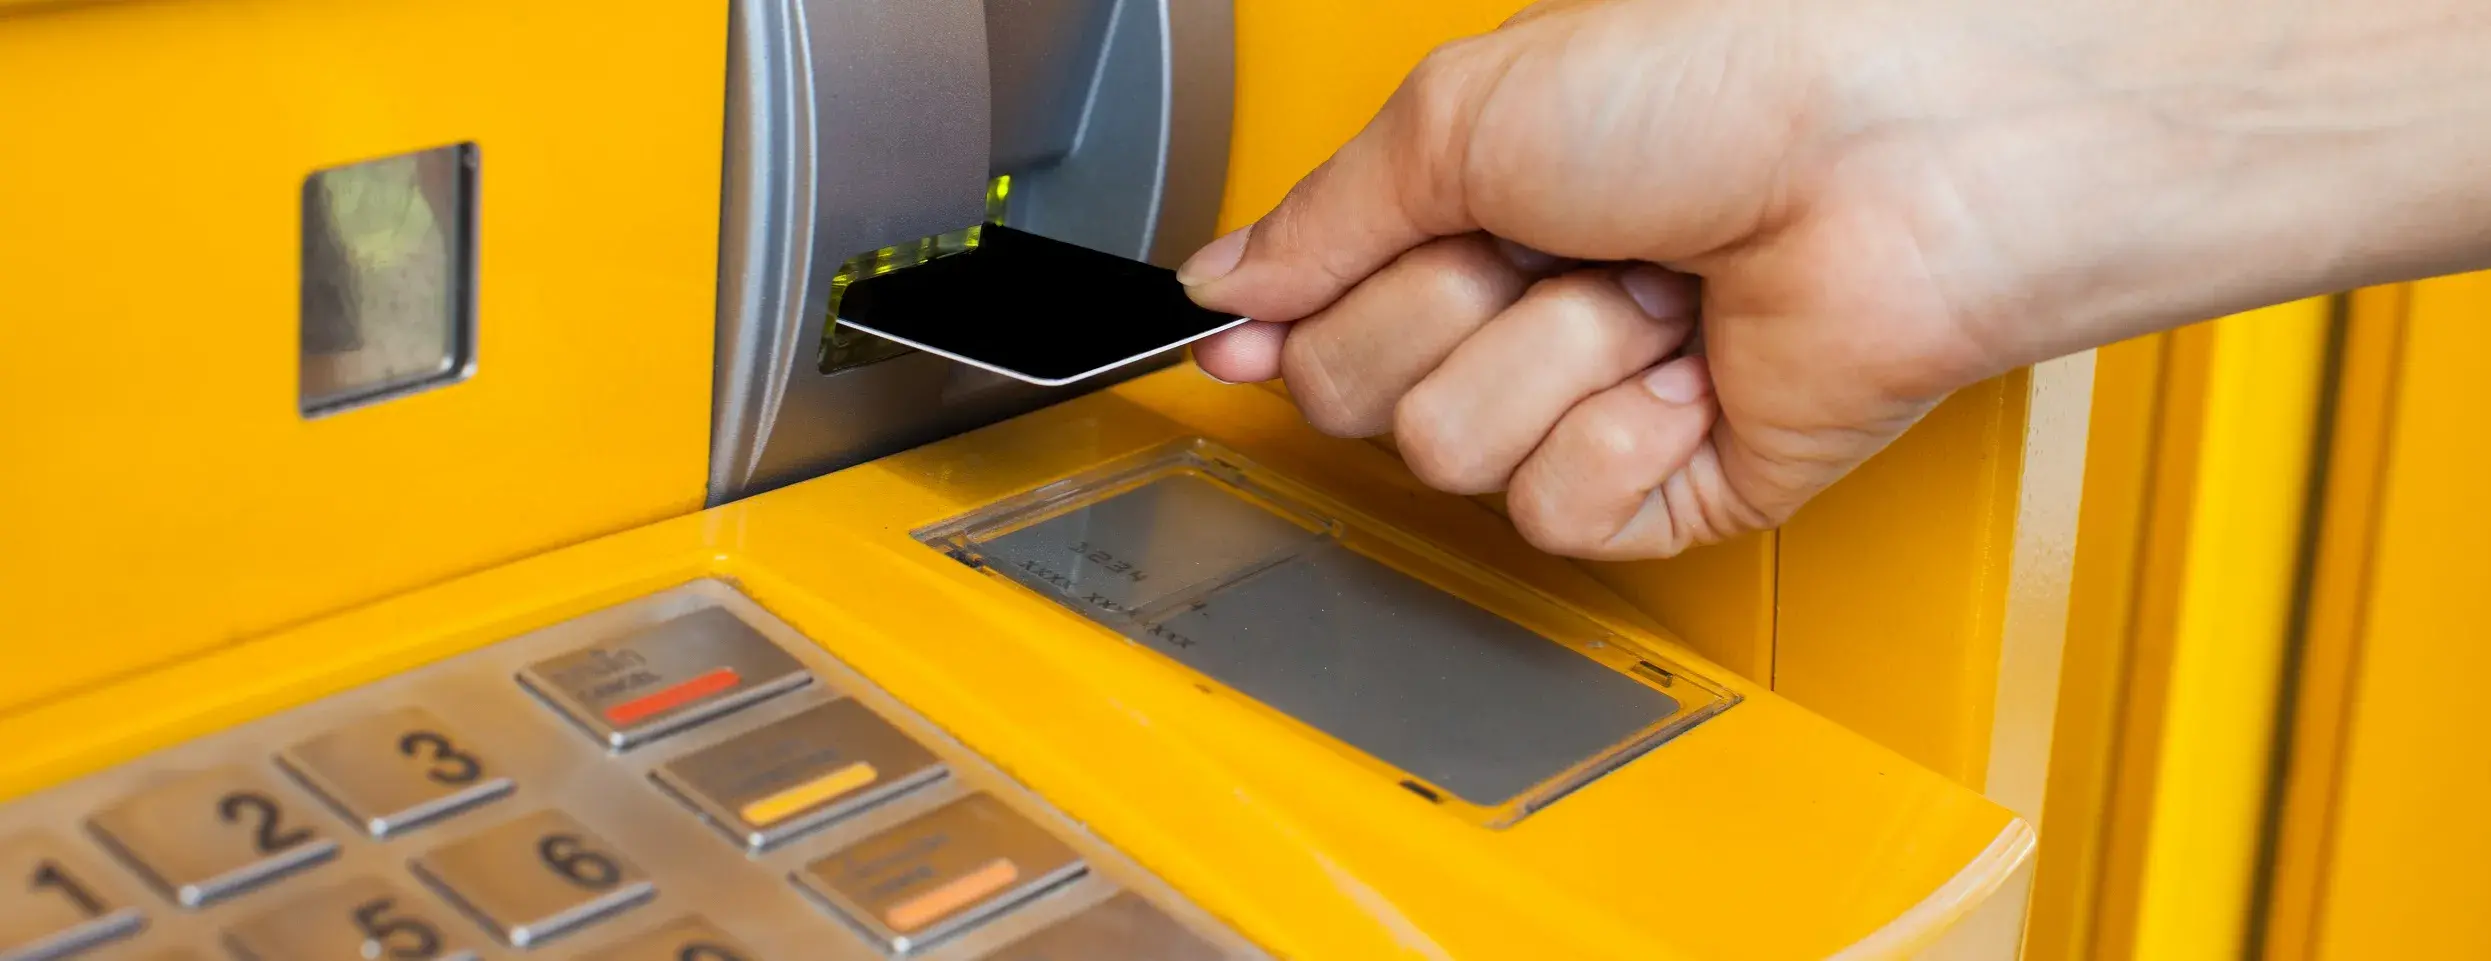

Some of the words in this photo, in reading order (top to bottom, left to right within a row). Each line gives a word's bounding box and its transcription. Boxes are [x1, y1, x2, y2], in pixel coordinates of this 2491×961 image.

[399, 731, 481, 784] 3
[217, 791, 314, 852] 2
[32, 858, 106, 916] 1
[536, 833, 620, 889] 6
[353, 898, 441, 961] 5
